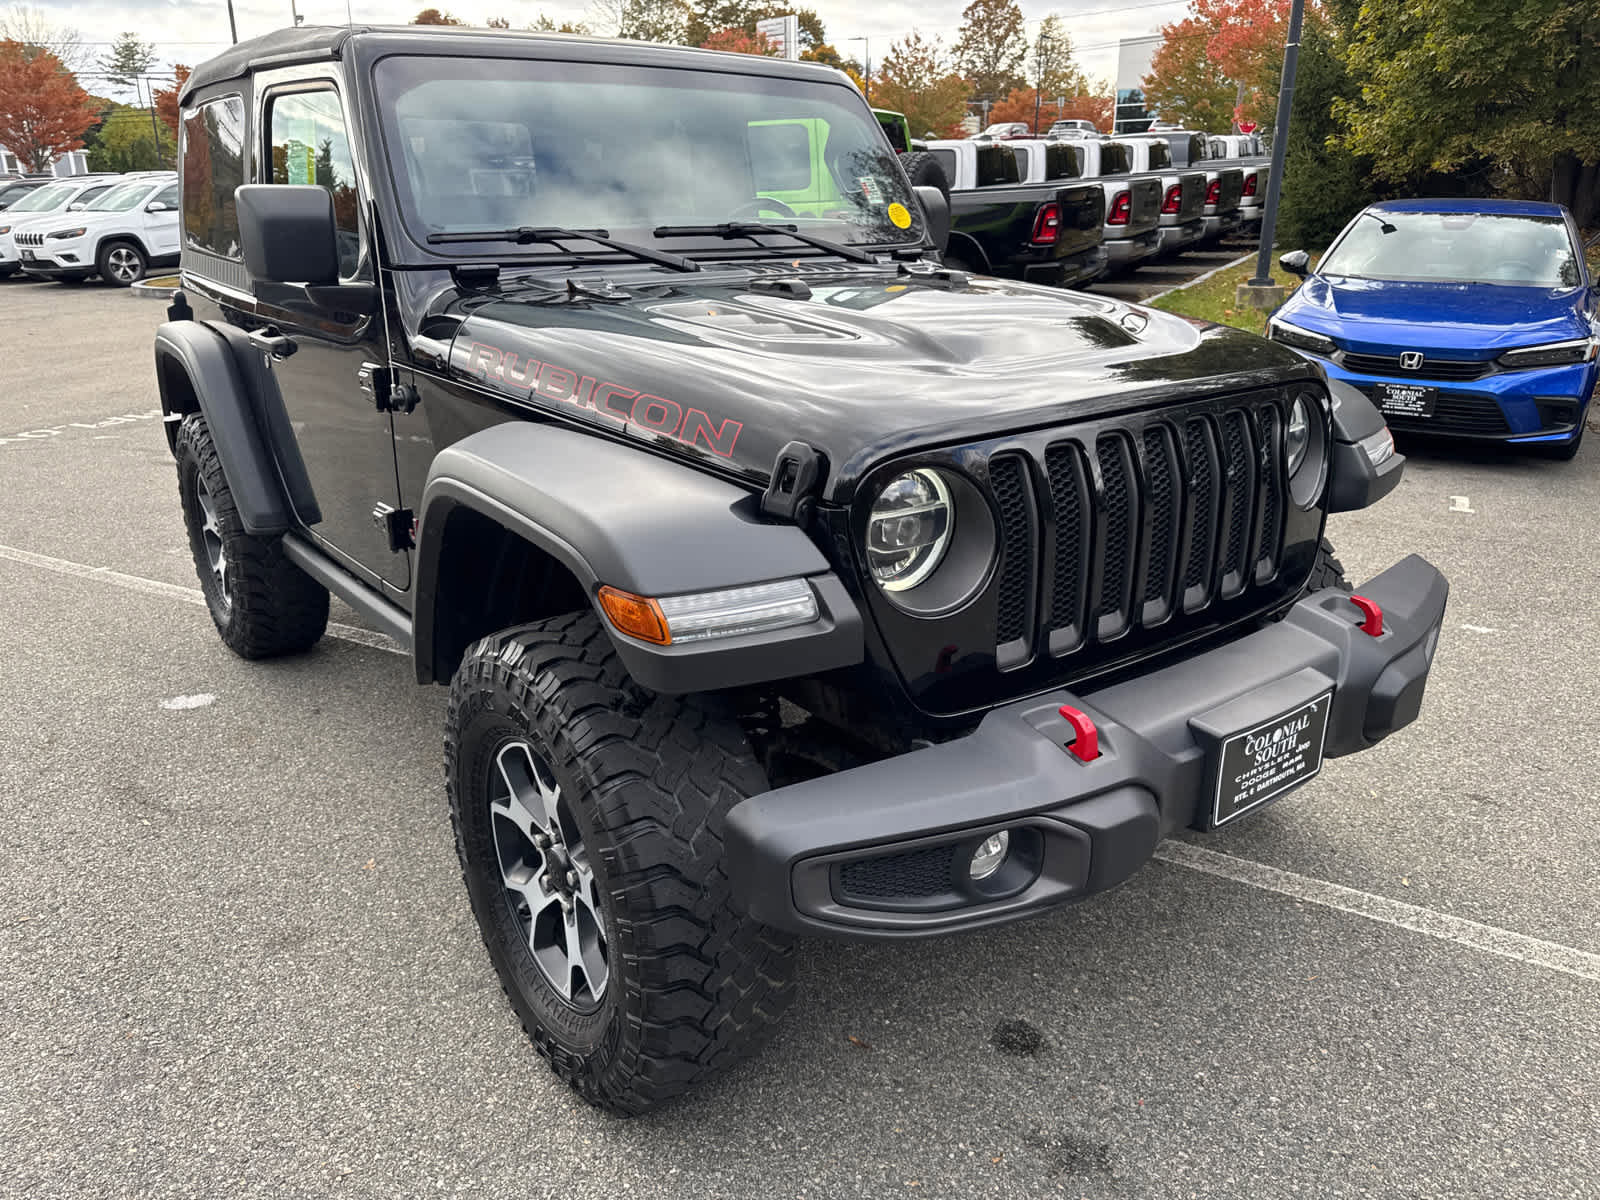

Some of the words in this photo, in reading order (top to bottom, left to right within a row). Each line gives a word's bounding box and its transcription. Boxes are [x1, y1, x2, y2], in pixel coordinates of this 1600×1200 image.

[466, 342, 743, 458] RUBICON
[1386, 388, 1424, 397] COLONIAL
[1245, 714, 1310, 756] COLONIAL
[1254, 733, 1298, 766] SOUTH
[1235, 752, 1290, 783] CHRYSLER
[1241, 768, 1276, 790] DODGE
[1282, 754, 1302, 769] RAM
